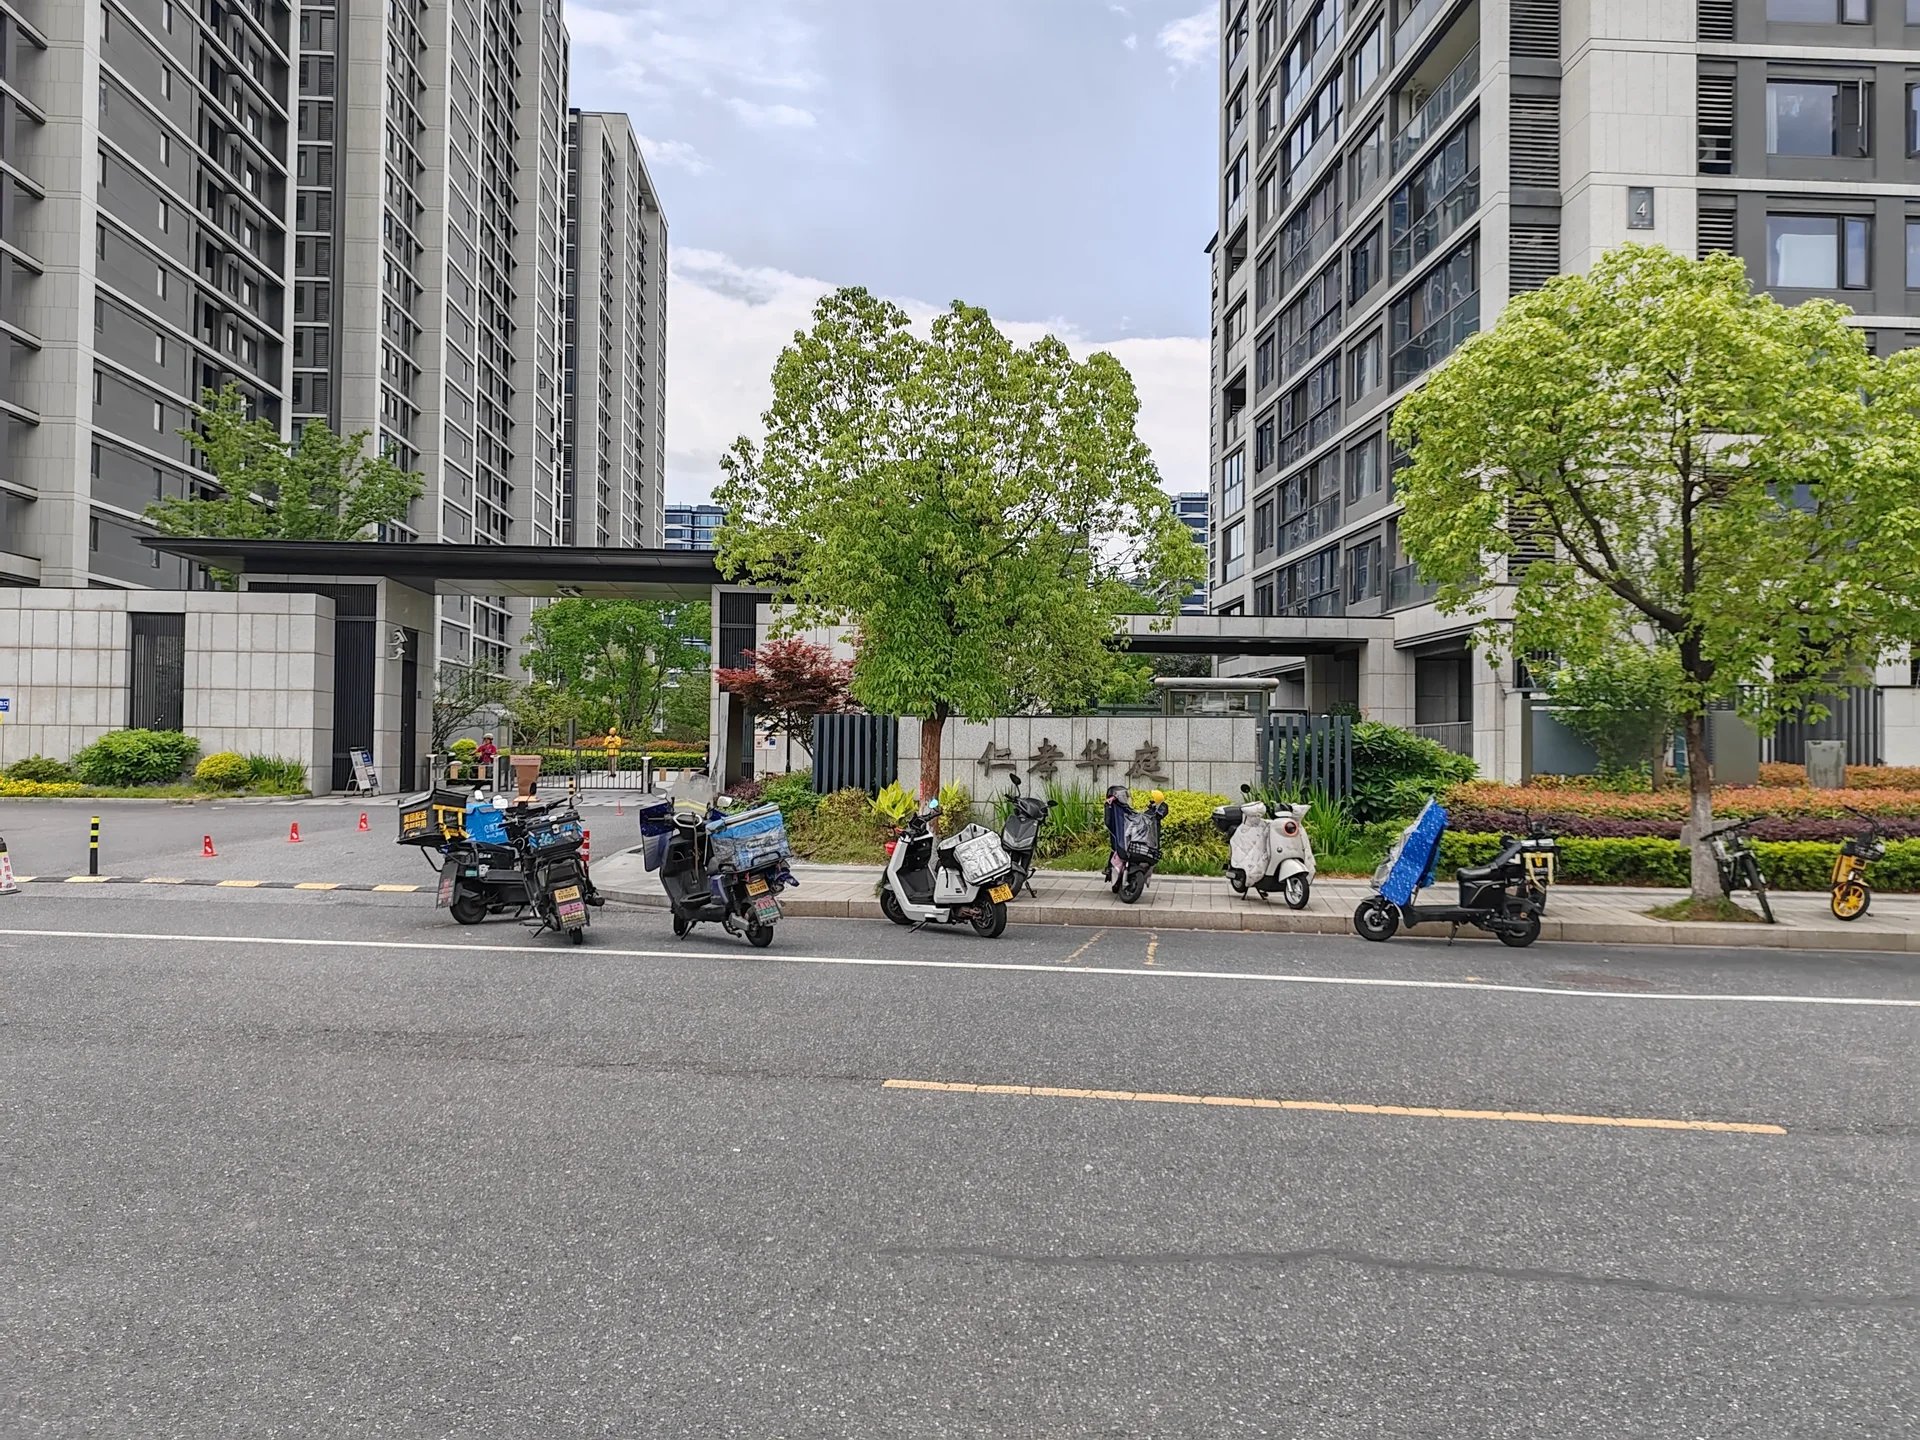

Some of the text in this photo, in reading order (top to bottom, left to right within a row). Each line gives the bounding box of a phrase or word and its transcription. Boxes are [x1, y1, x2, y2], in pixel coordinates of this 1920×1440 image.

[1636, 202, 1647, 216] 4
[977, 738, 1169, 782] 仁孝华庭
